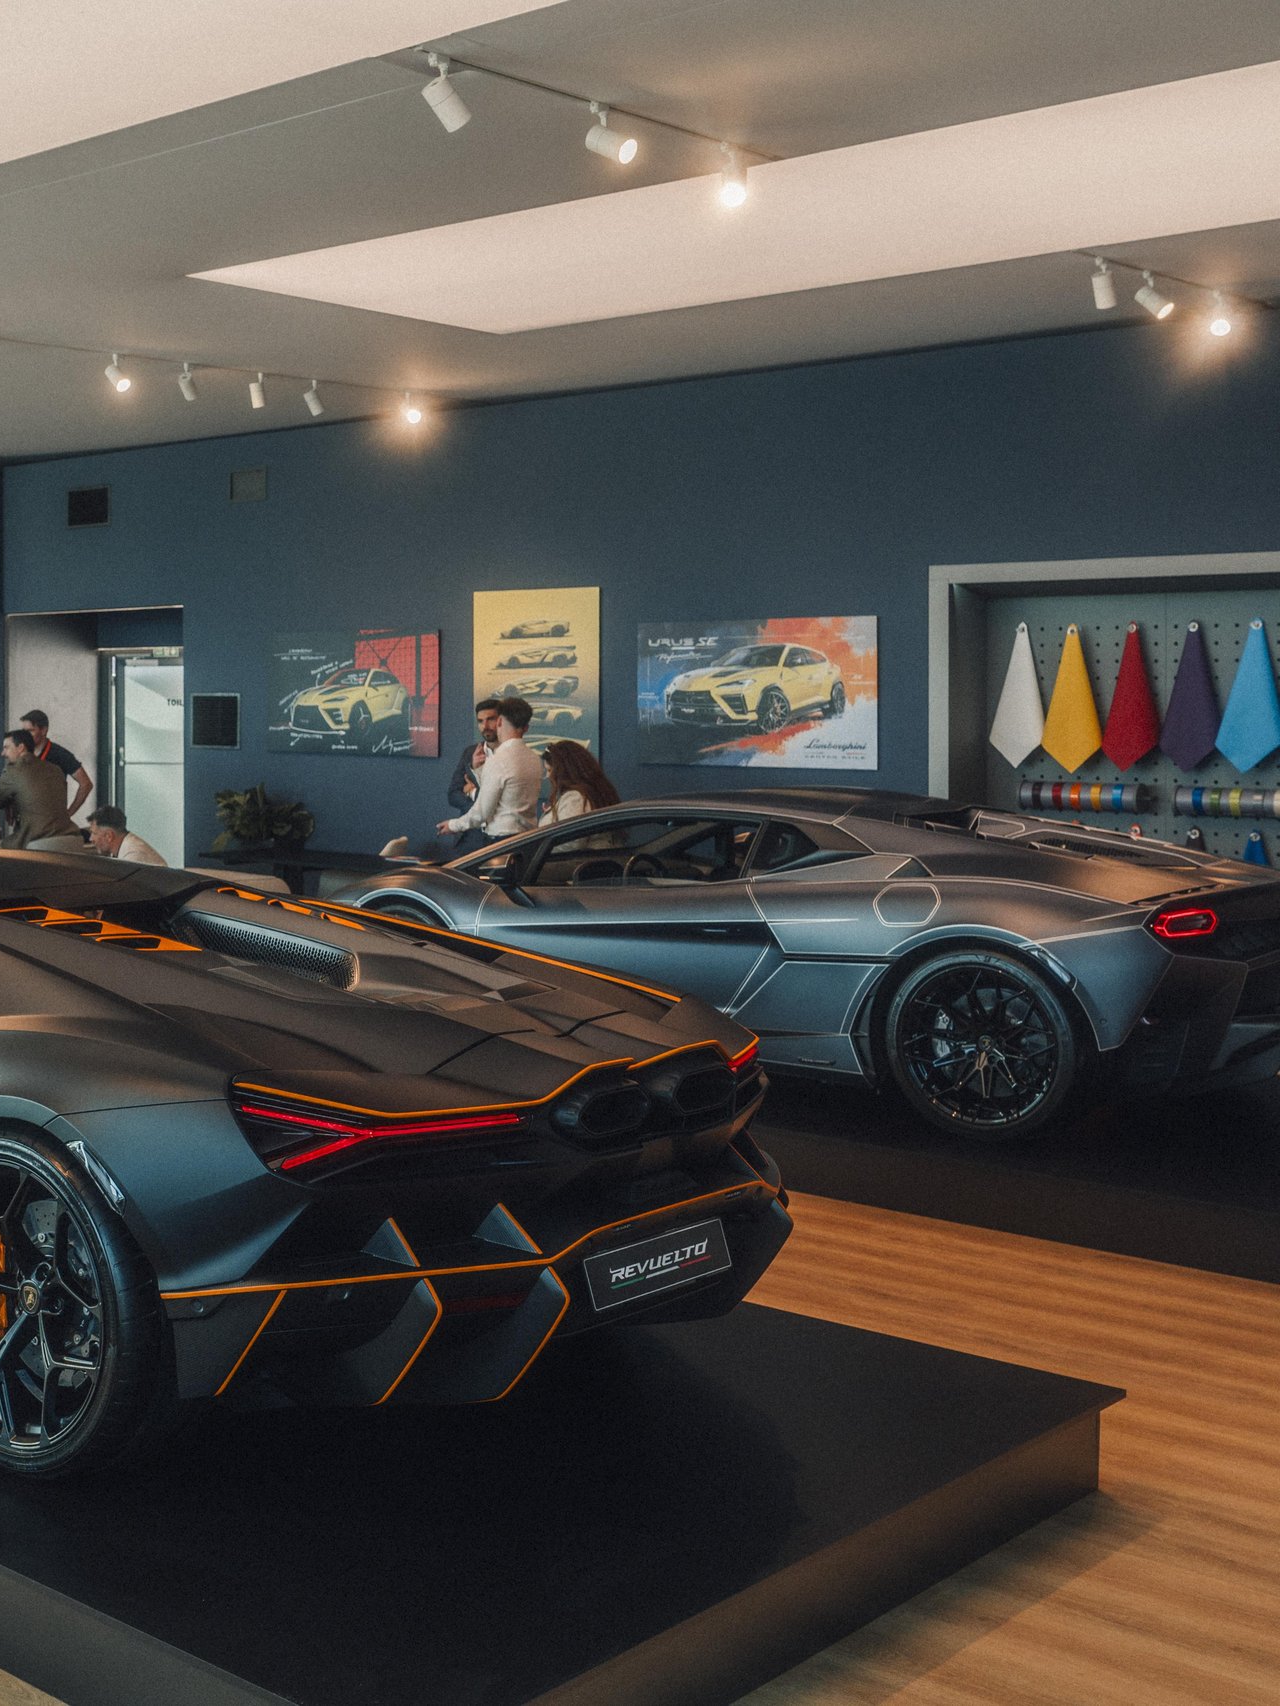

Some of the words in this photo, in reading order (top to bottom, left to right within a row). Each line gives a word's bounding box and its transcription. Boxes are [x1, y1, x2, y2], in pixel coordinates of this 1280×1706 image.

[648, 638, 694, 647] URUS
[695, 636, 719, 647] SE
[803, 738, 868, 752] Lamborghini
[609, 1237, 708, 1283] REVUELTO
